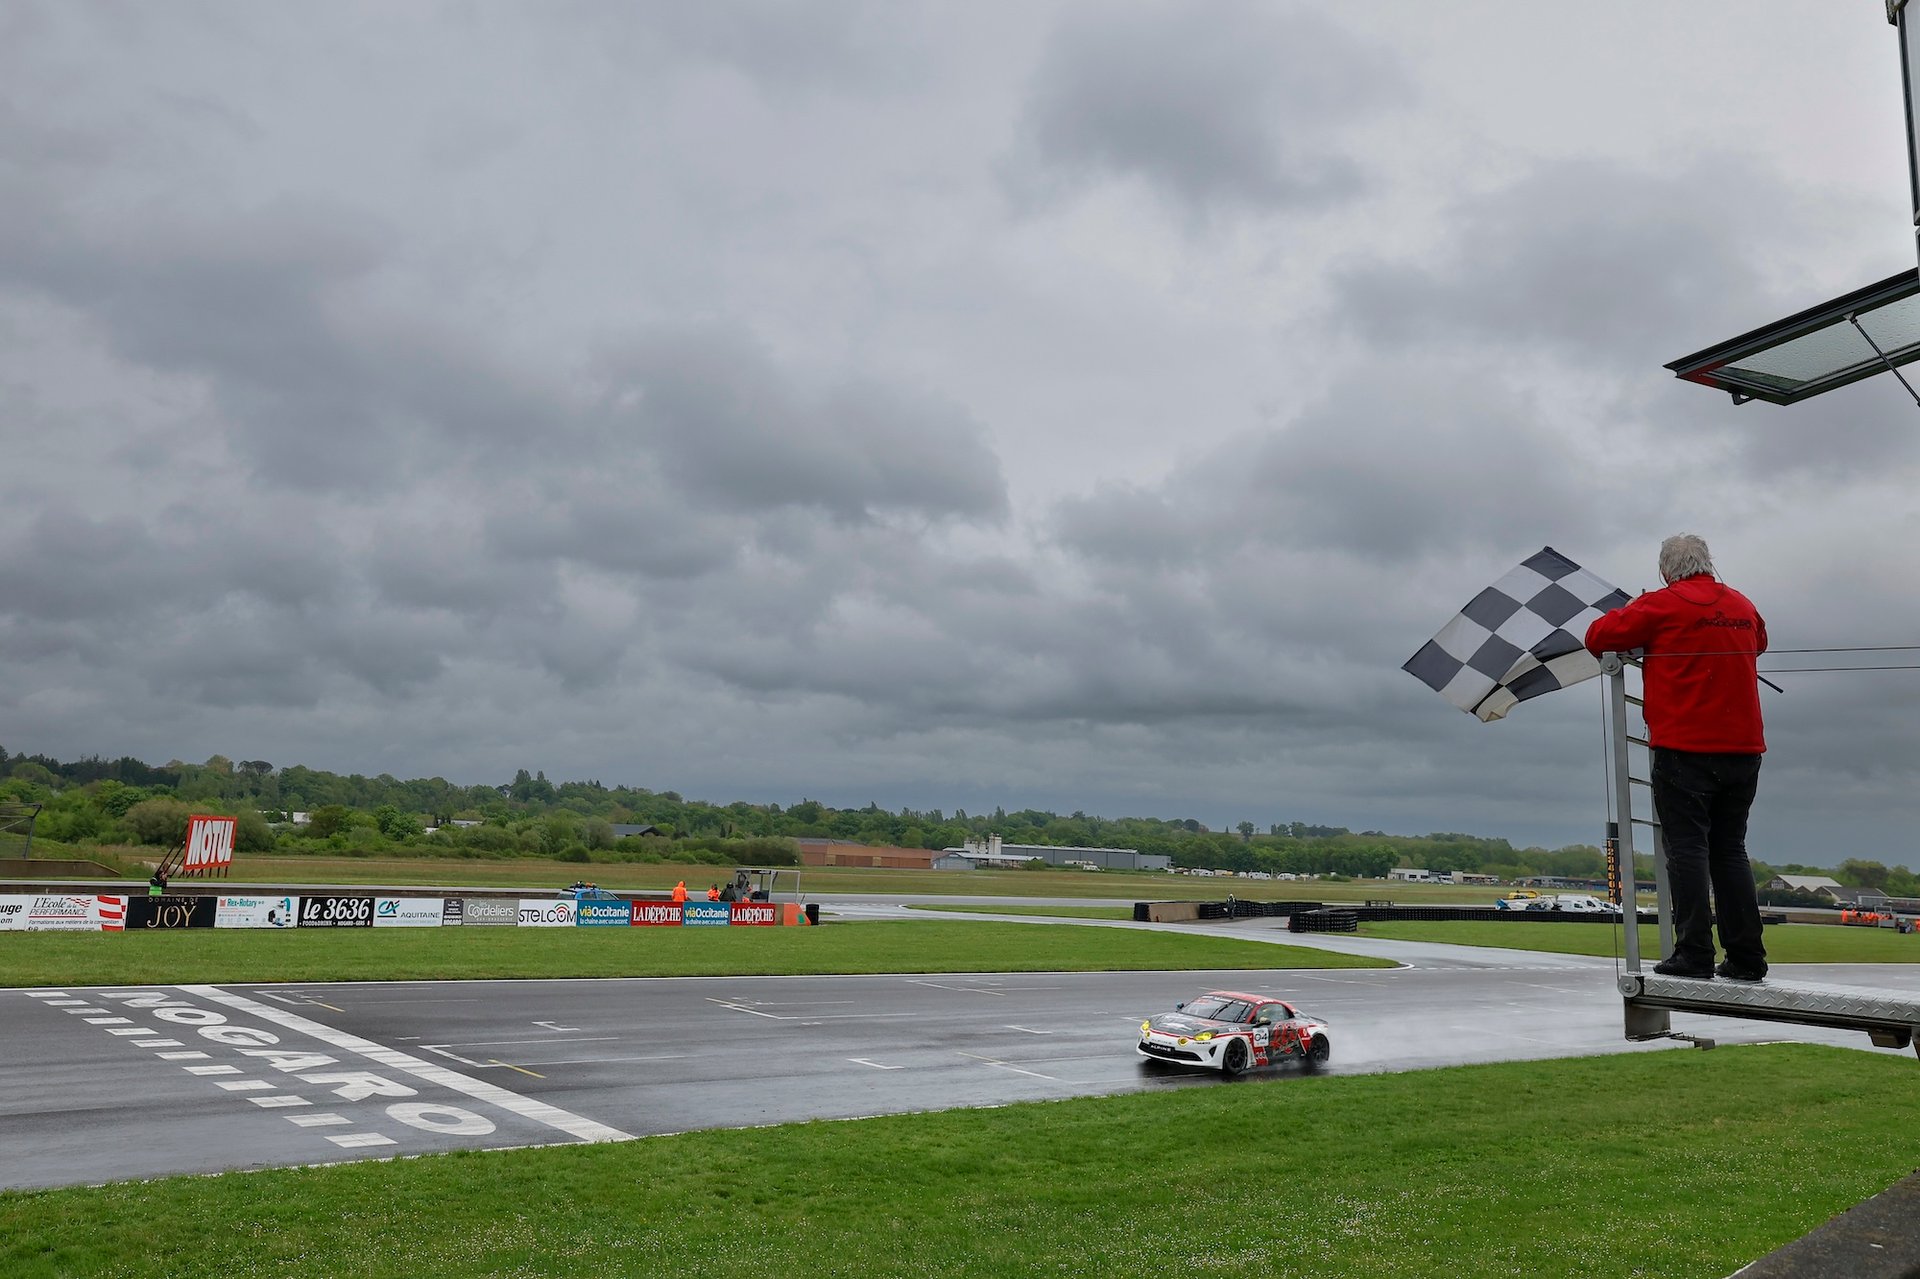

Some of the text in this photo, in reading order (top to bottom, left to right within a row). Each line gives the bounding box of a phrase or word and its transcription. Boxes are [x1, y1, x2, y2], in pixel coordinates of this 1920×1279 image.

[186, 819, 235, 866] MOTUL
[0, 904, 23, 916] uge
[227, 898, 257, 909] Rex-Rotary
[303, 898, 371, 920] le 3636
[400, 911, 441, 919] AQUITAINE
[467, 904, 514, 918] Cordeliers
[1150, 1044, 1171, 1052] ALPINE
[98, 992, 497, 1136] NOGARO
